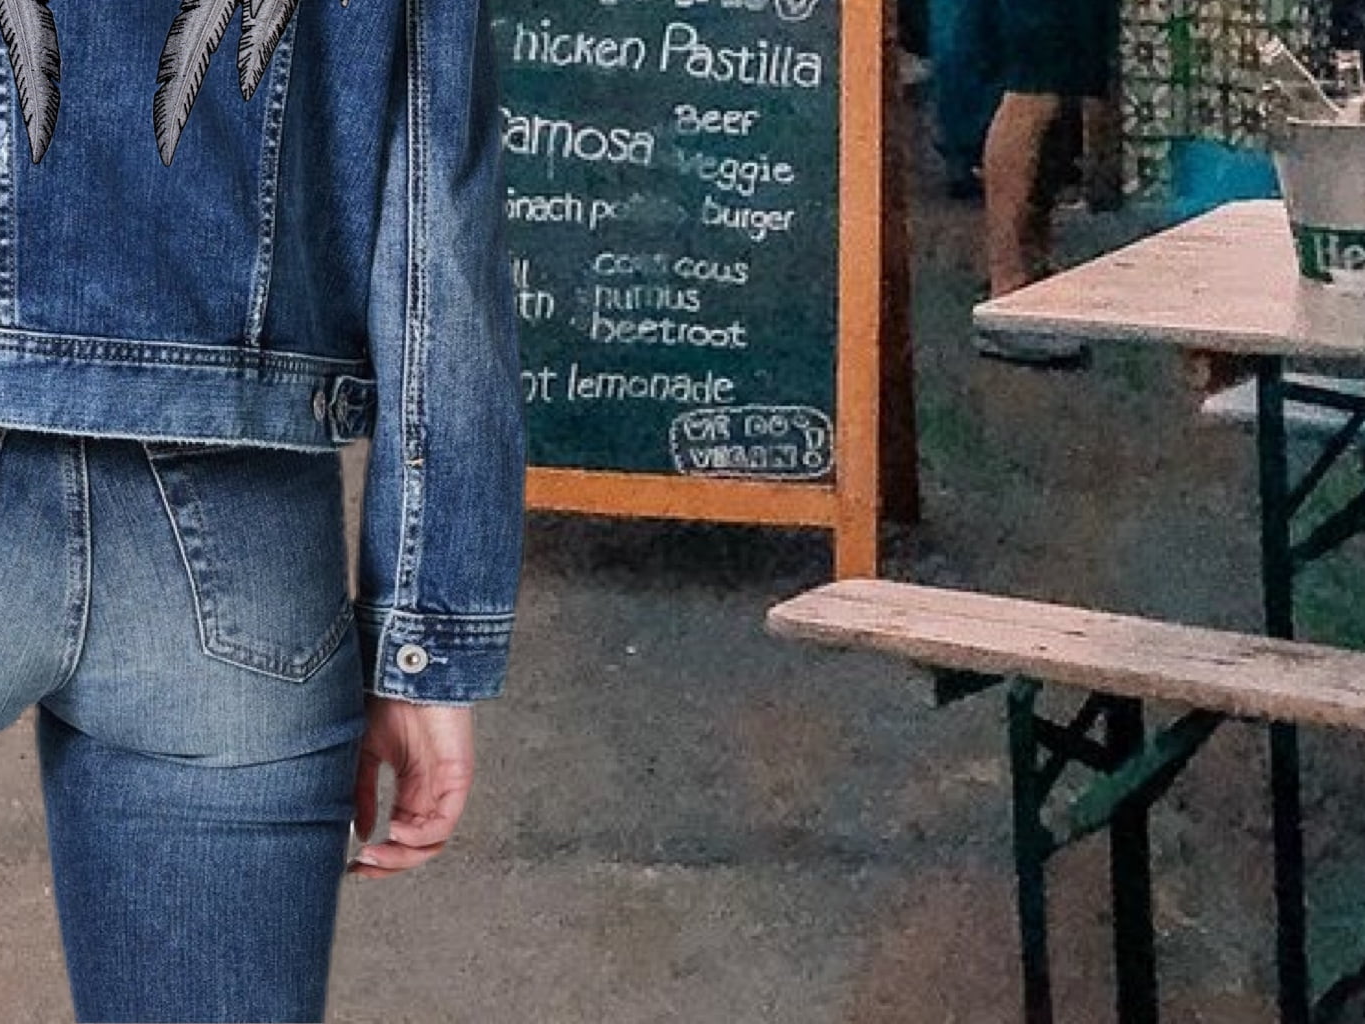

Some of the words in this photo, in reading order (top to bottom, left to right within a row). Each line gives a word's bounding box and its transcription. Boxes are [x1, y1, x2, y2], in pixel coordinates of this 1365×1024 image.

[491, 19, 646, 70] hicken
[660, 22, 822, 88] Pastilla
[506, 186, 583, 224] inach
[701, 194, 795, 242] burger
[589, 311, 749, 349] beetroot
[567, 362, 735, 404] lemonade
